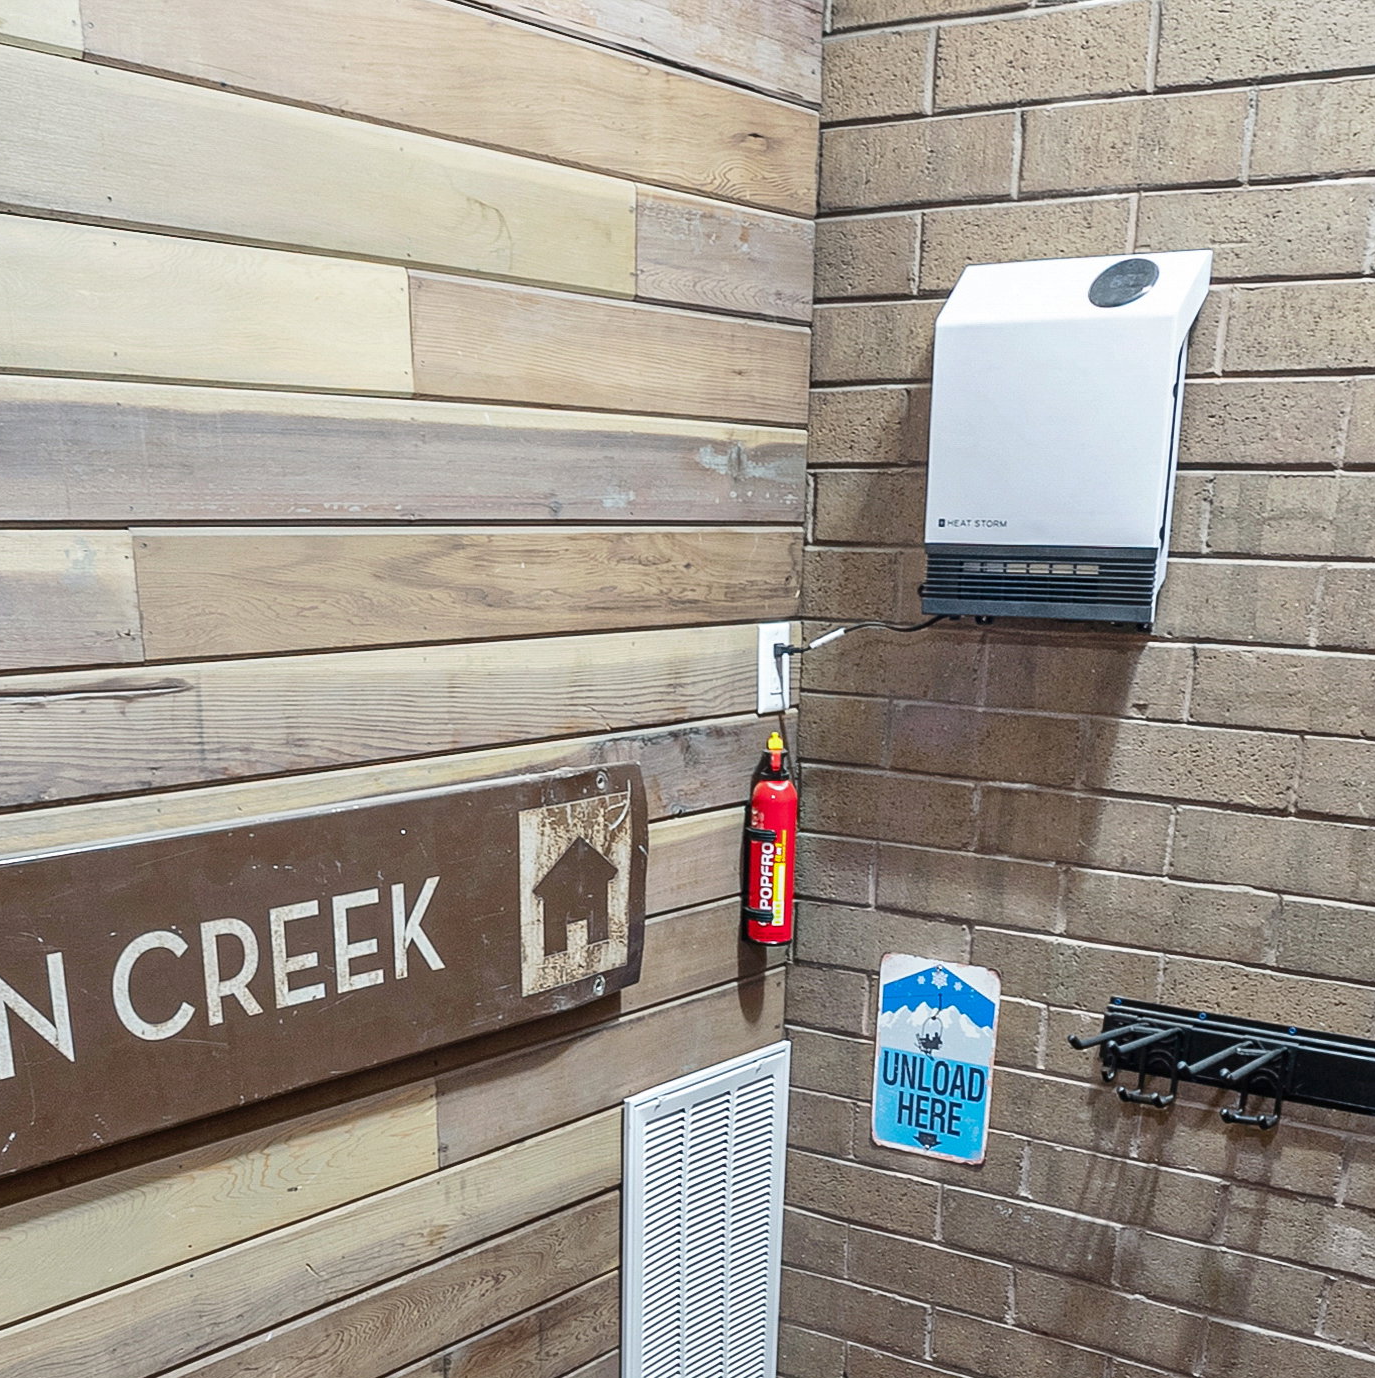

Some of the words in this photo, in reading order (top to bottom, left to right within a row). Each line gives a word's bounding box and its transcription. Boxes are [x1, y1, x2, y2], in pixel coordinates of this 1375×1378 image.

[947, 519, 972, 528] HEAT
[974, 519, 1008, 528] STORM
[113, 876, 445, 1040] CREEK
[883, 1050, 985, 1103] UNLOAD
[897, 1090, 963, 1137] HERE
